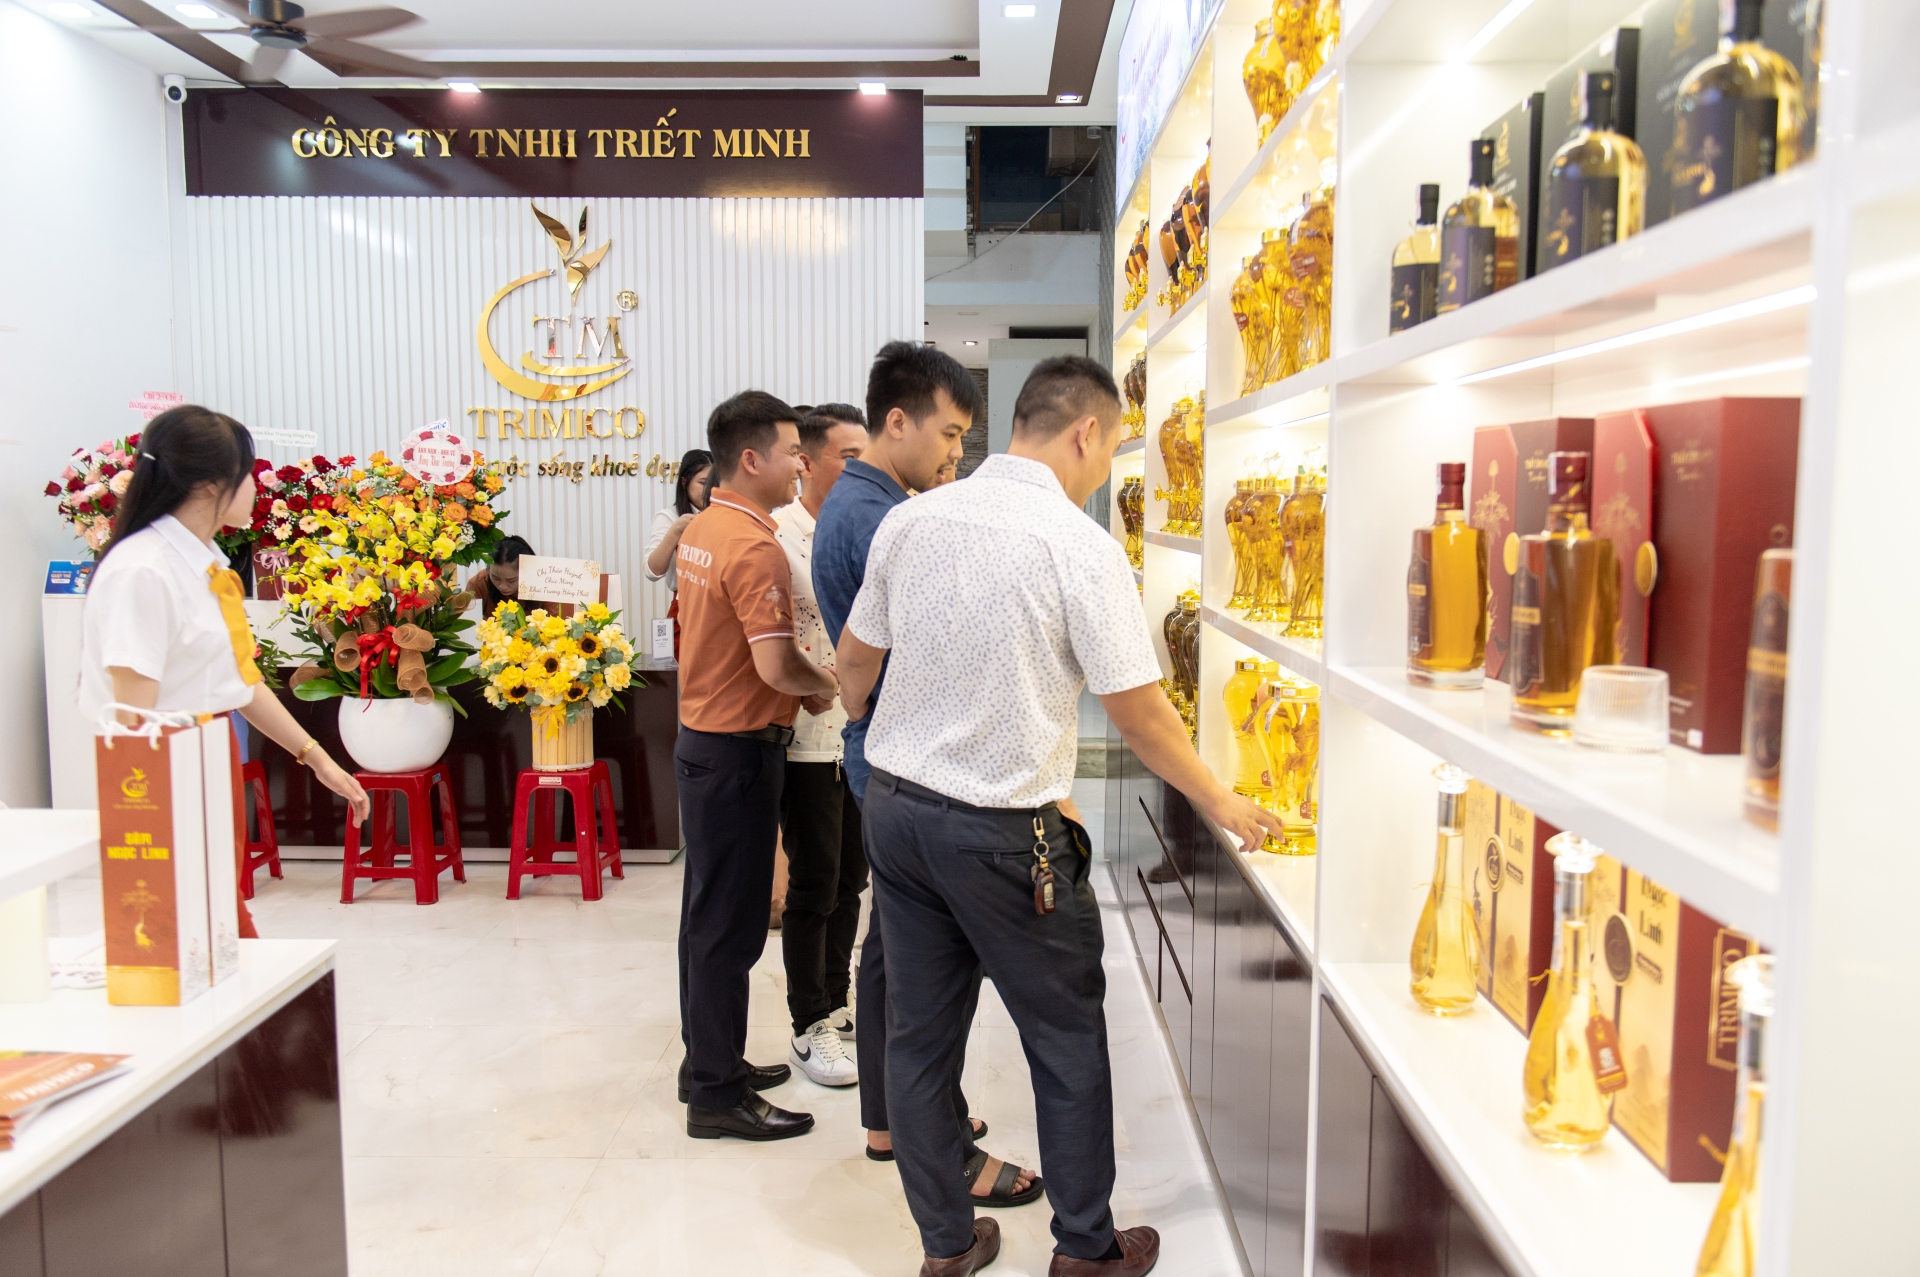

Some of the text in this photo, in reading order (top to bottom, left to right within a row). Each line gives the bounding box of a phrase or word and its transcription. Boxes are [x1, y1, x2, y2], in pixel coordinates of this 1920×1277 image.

[292, 108, 811, 158] CÔNG TY TNHH TRIẾT MINH
[532, 313, 629, 359] TM
[466, 406, 646, 440] TRIMICO
[537, 451, 586, 484] sống
